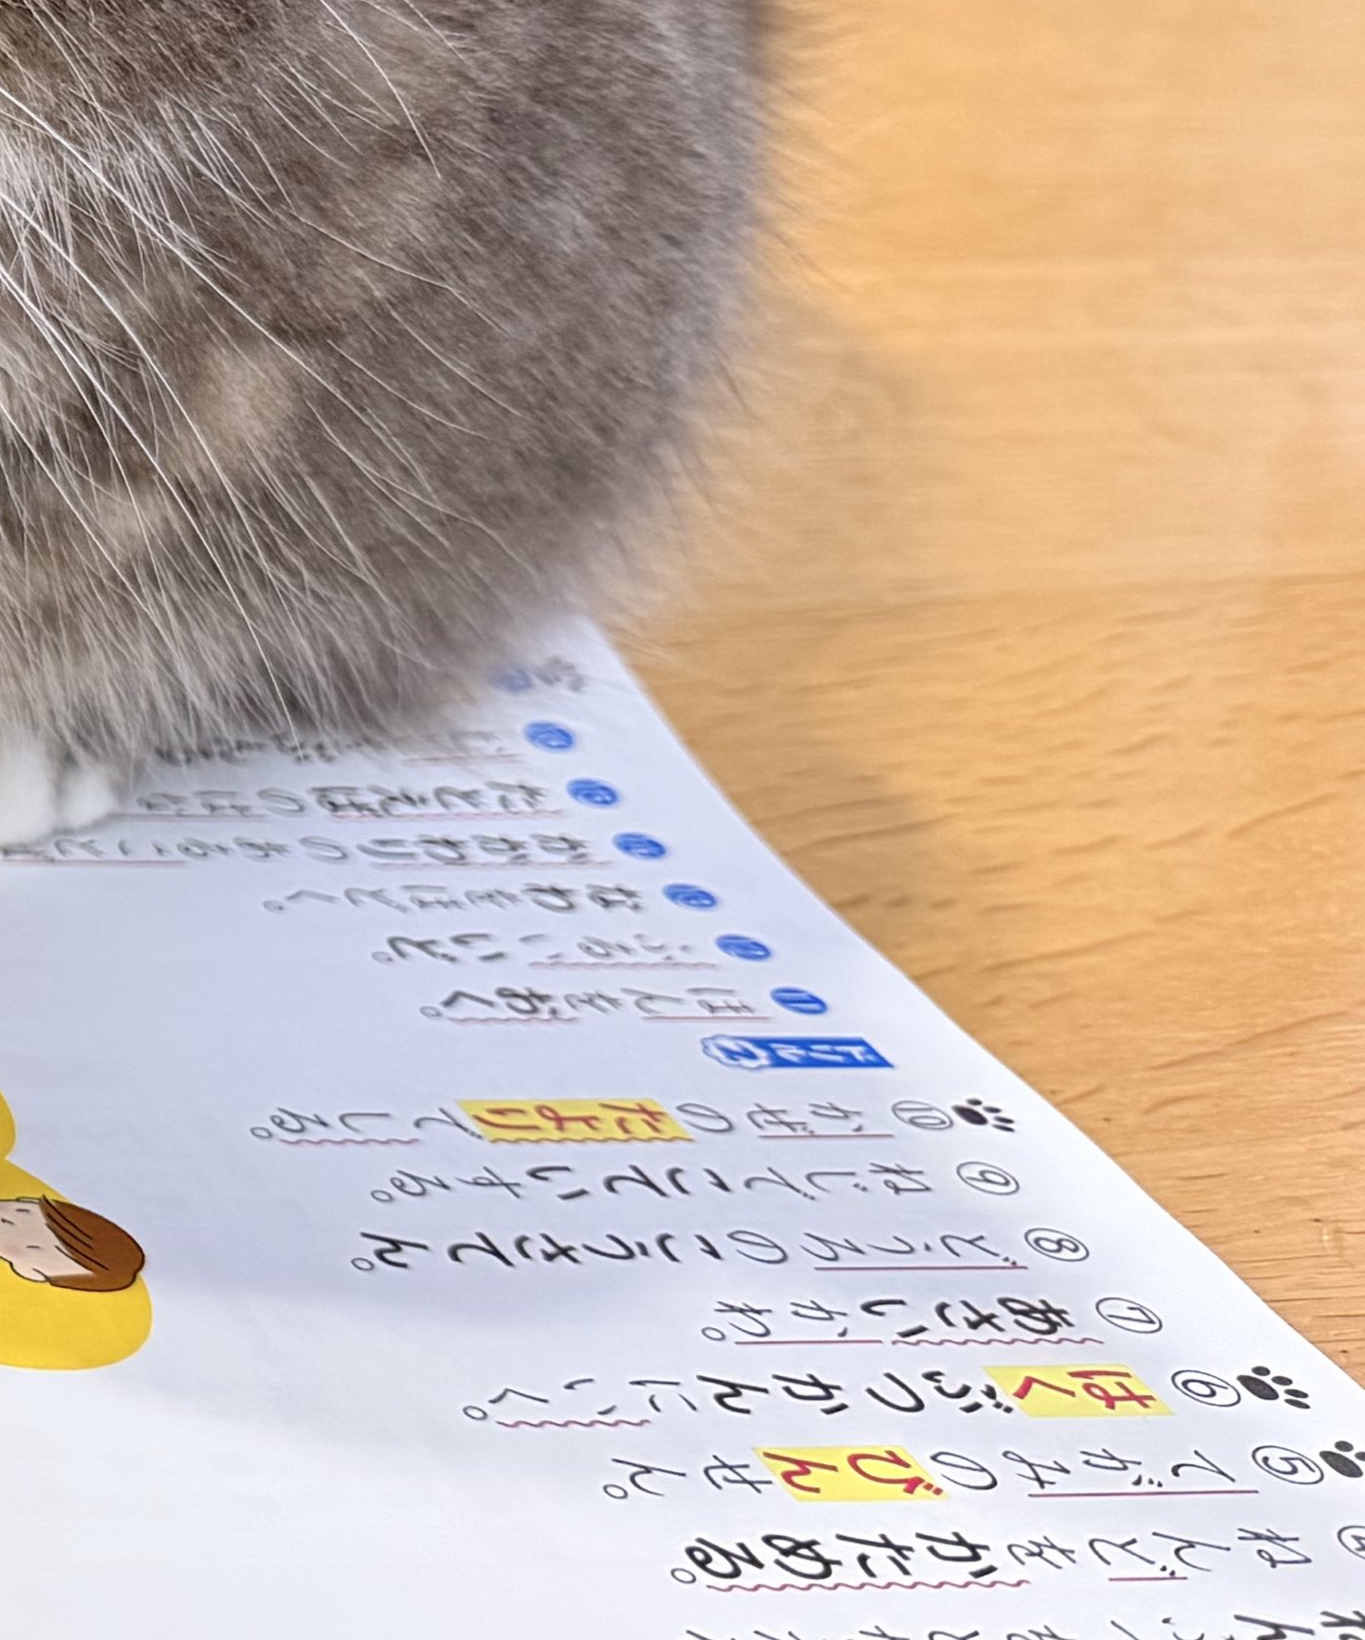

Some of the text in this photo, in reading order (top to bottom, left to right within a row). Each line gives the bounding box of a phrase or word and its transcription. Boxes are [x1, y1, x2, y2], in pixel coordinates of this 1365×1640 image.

[419, 986, 758, 1020] ほんをおく。
[771, 1040, 876, 1066] ドリル
[250, 1100, 864, 1141] かぜのたよりでしる。
[369, 1161, 933, 1204] ねじでこていする。
[351, 1228, 1019, 1273] どうろのこうさてん。
[700, 1297, 1075, 1342] あさいかわ。
[462, 1369, 1159, 1422] はくぶつかんにいく。
[602, 1448, 1237, 1501] てがみのびんせん。
[670, 1527, 1314, 1586] ねんどをかためる。
